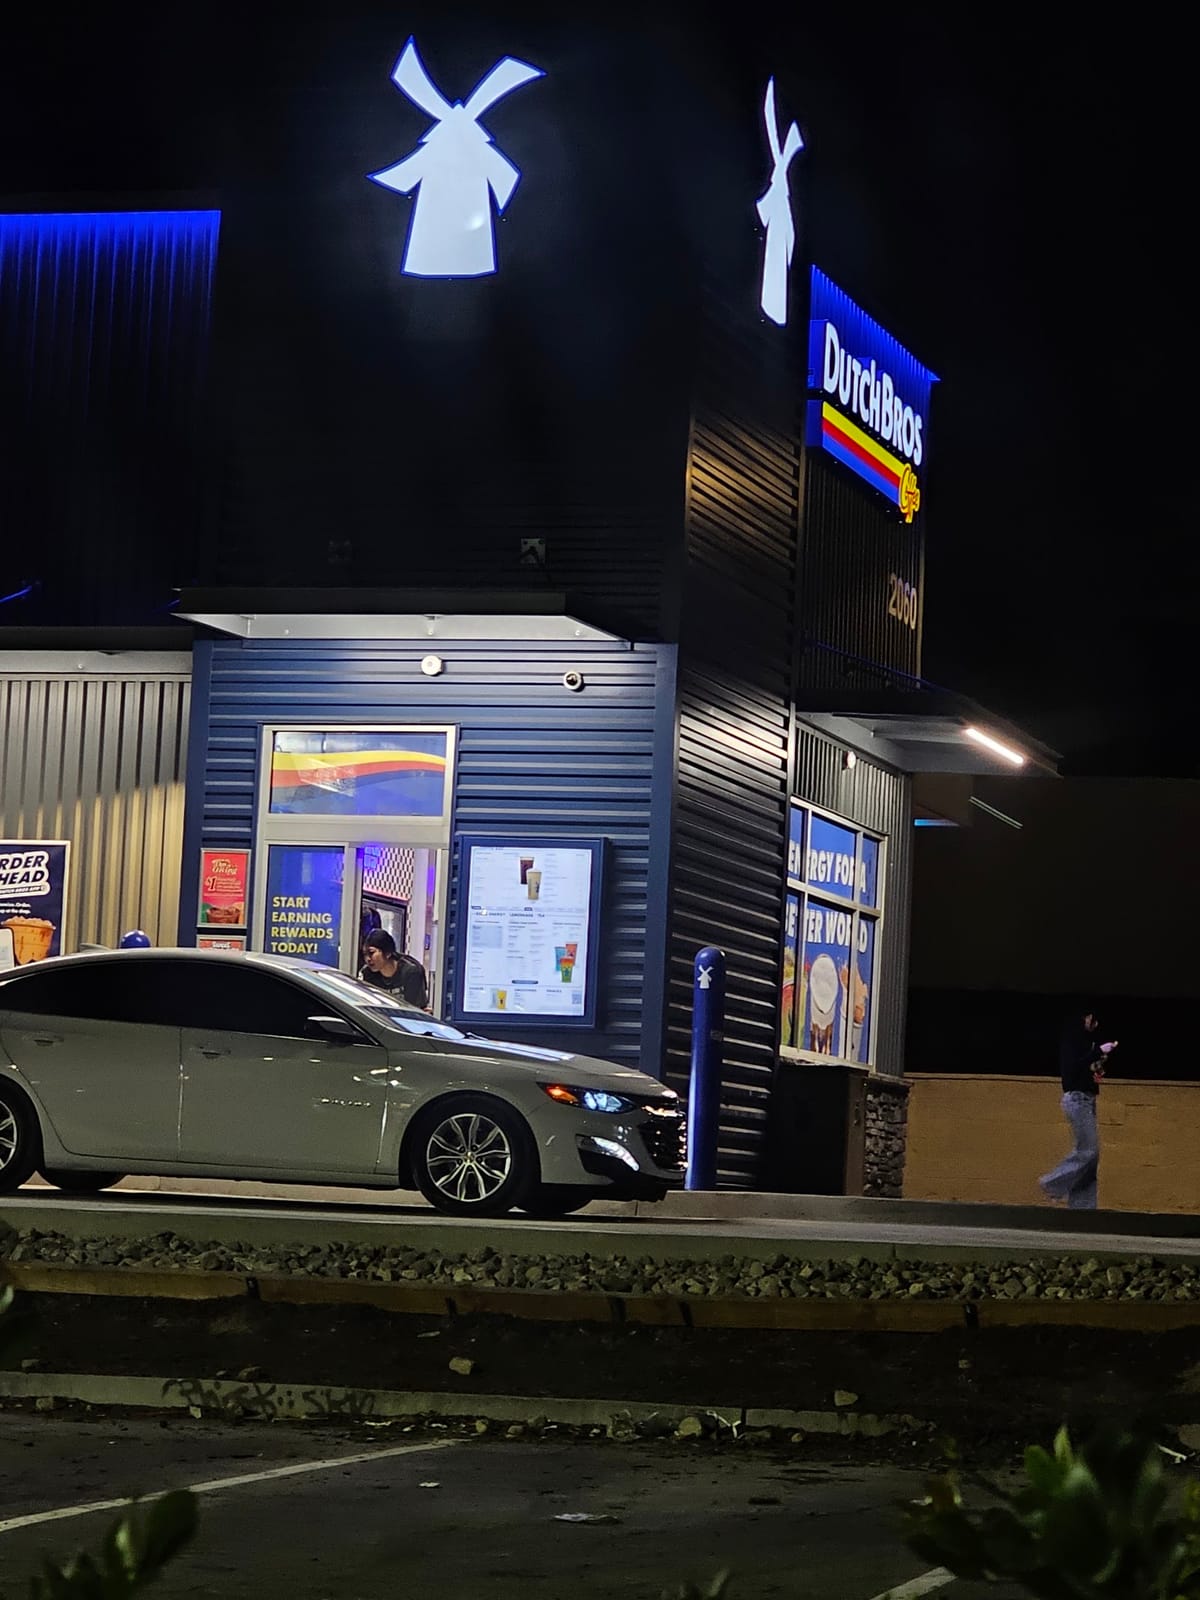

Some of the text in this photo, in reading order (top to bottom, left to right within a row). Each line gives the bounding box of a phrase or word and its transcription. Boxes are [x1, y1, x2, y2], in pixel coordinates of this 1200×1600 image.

[888, 572, 917, 630] 2060
[0, 855, 45, 870] RDER
[788, 840, 834, 883] ENRGY
[0, 871, 45, 885] HEAD
[273, 897, 311, 908] START
[271, 912, 332, 924] EARNING
[271, 927, 333, 939] REWARDS
[825, 911, 867, 953] WORD
[271, 942, 318, 954] TODAY!
